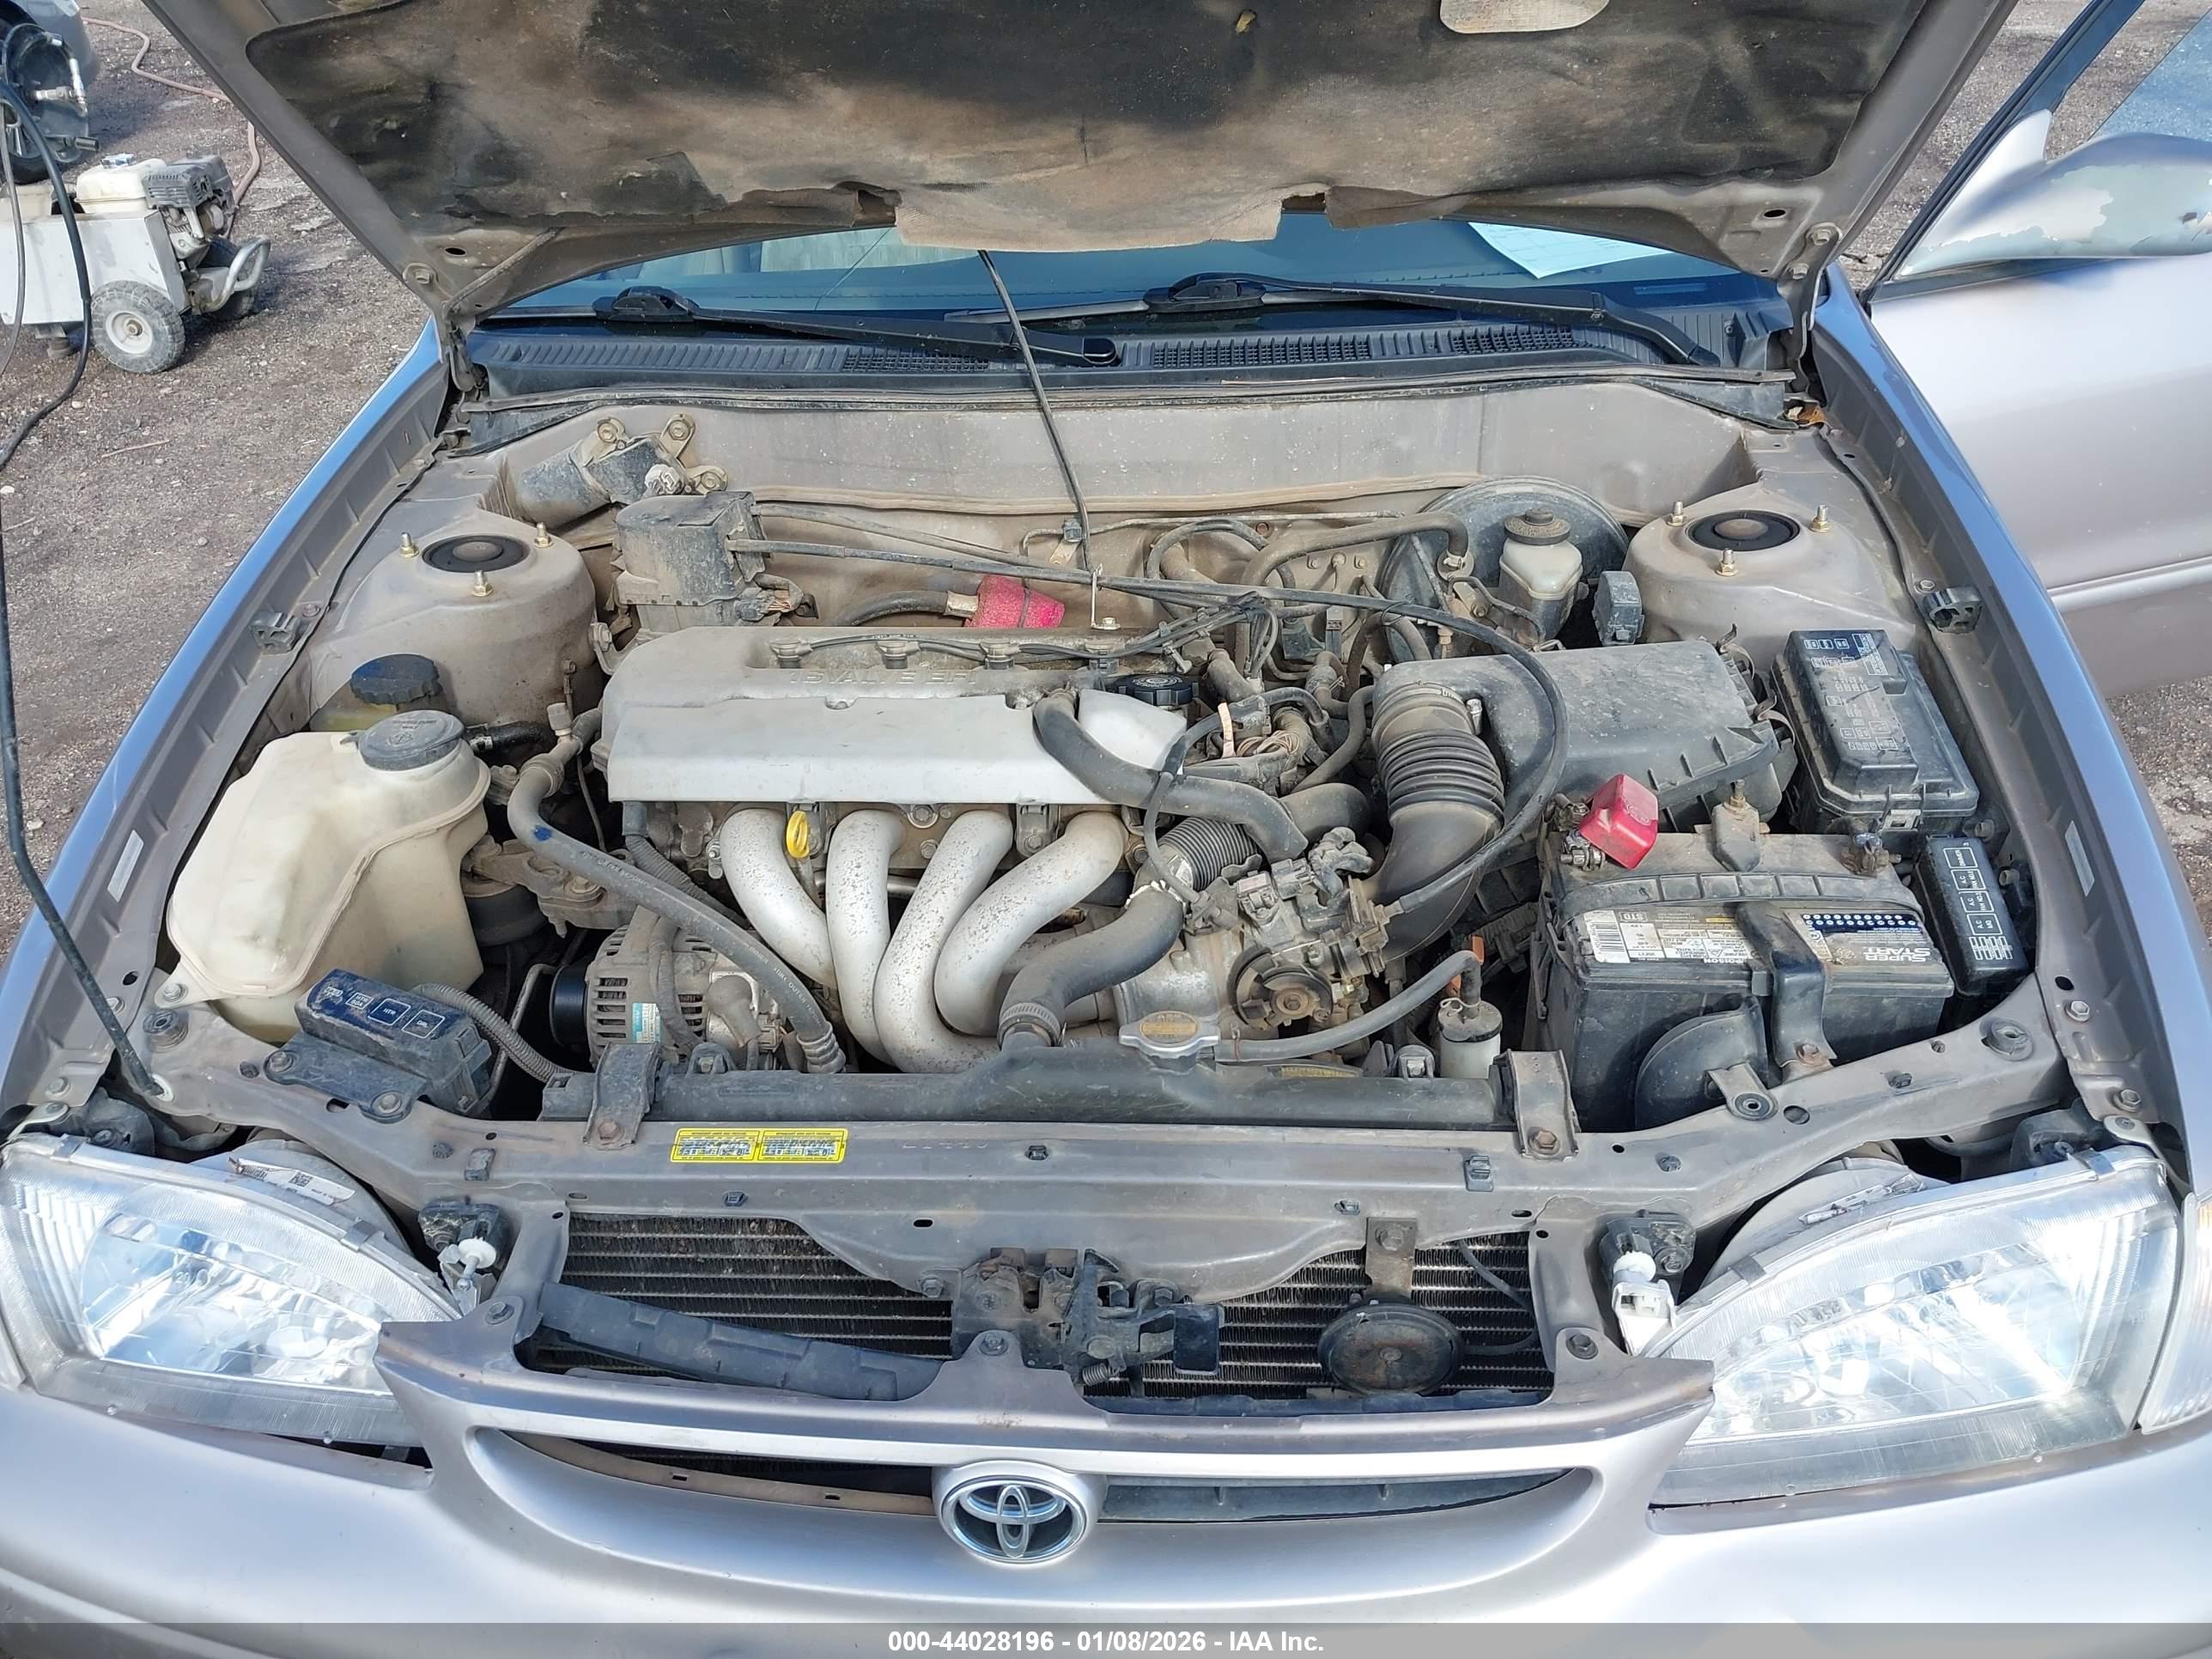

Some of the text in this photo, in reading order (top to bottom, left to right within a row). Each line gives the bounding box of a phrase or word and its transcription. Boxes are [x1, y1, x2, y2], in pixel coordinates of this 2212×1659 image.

[1954, 849, 1966, 866] DIMMER
[1863, 947, 1931, 957] START
[1866, 954, 1927, 963] SUPER
[383, 1007, 396, 1016] HTR
